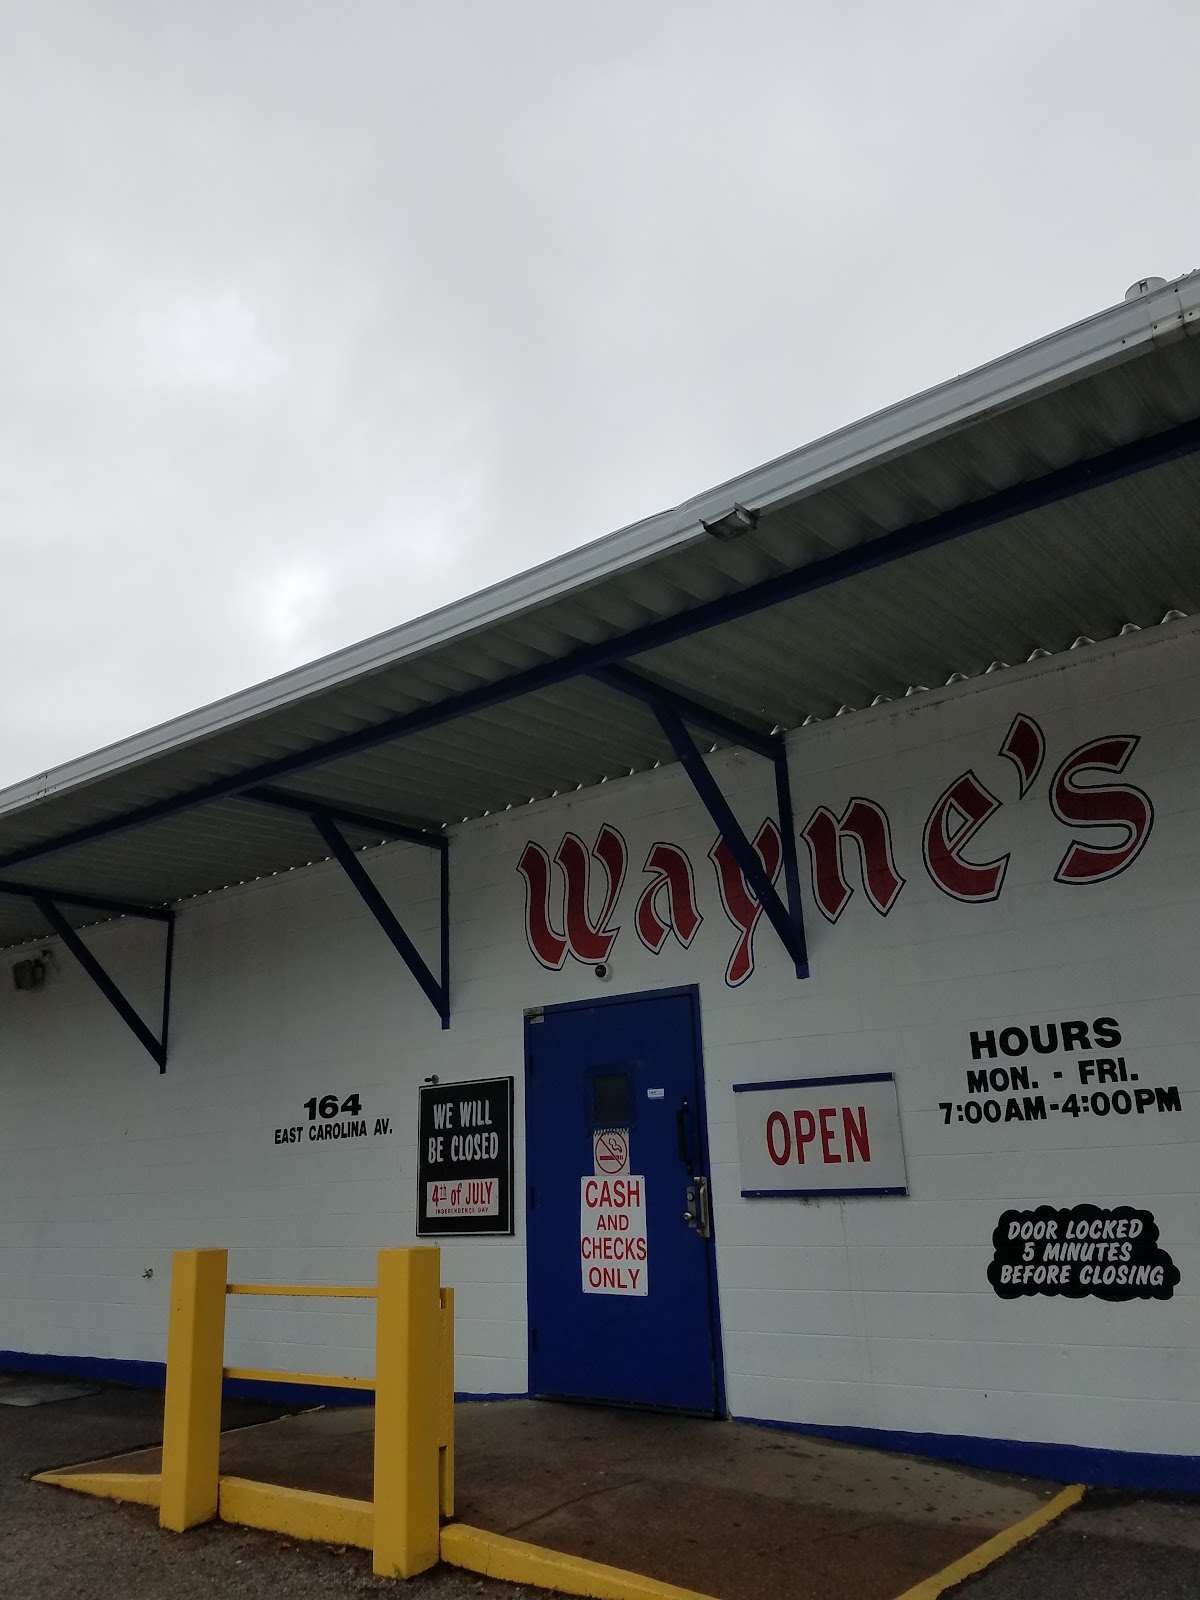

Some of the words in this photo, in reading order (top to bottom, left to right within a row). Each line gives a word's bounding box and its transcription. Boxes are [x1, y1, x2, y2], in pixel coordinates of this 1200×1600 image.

[969, 1017, 1122, 1060] HOURS
[966, 1066, 1039, 1094] MON.
[1077, 1057, 1139, 1085] FRI.
[303, 1093, 362, 1121] 164
[433, 1102, 454, 1130] WE
[460, 1099, 493, 1128] WILL
[274, 1126, 304, 1145] EAST
[308, 1120, 368, 1142] CAROLINA
[373, 1117, 393, 1136] AV.
[766, 1106, 871, 1166] OPEN
[427, 1136, 444, 1164] BE
[450, 1131, 499, 1162] CLOSED
[450, 1182, 463, 1207] of
[465, 1180, 493, 1206] JULY
[585, 1180, 641, 1208] CASH
[435, 1207, 475, 1215] INDEPENDENCE
[596, 1214, 630, 1231] AND
[1007, 1220, 1058, 1241] DOOR
[1065, 1218, 1144, 1240] LOCKED
[581, 1236, 648, 1261] CHECKS
[1022, 1241, 1036, 1262] 5
[1042, 1241, 1133, 1262] MINUTES
[588, 1266, 641, 1289] ONLY
[1000, 1264, 1072, 1285] BEFORE
[1079, 1264, 1165, 1287] CLOSING
